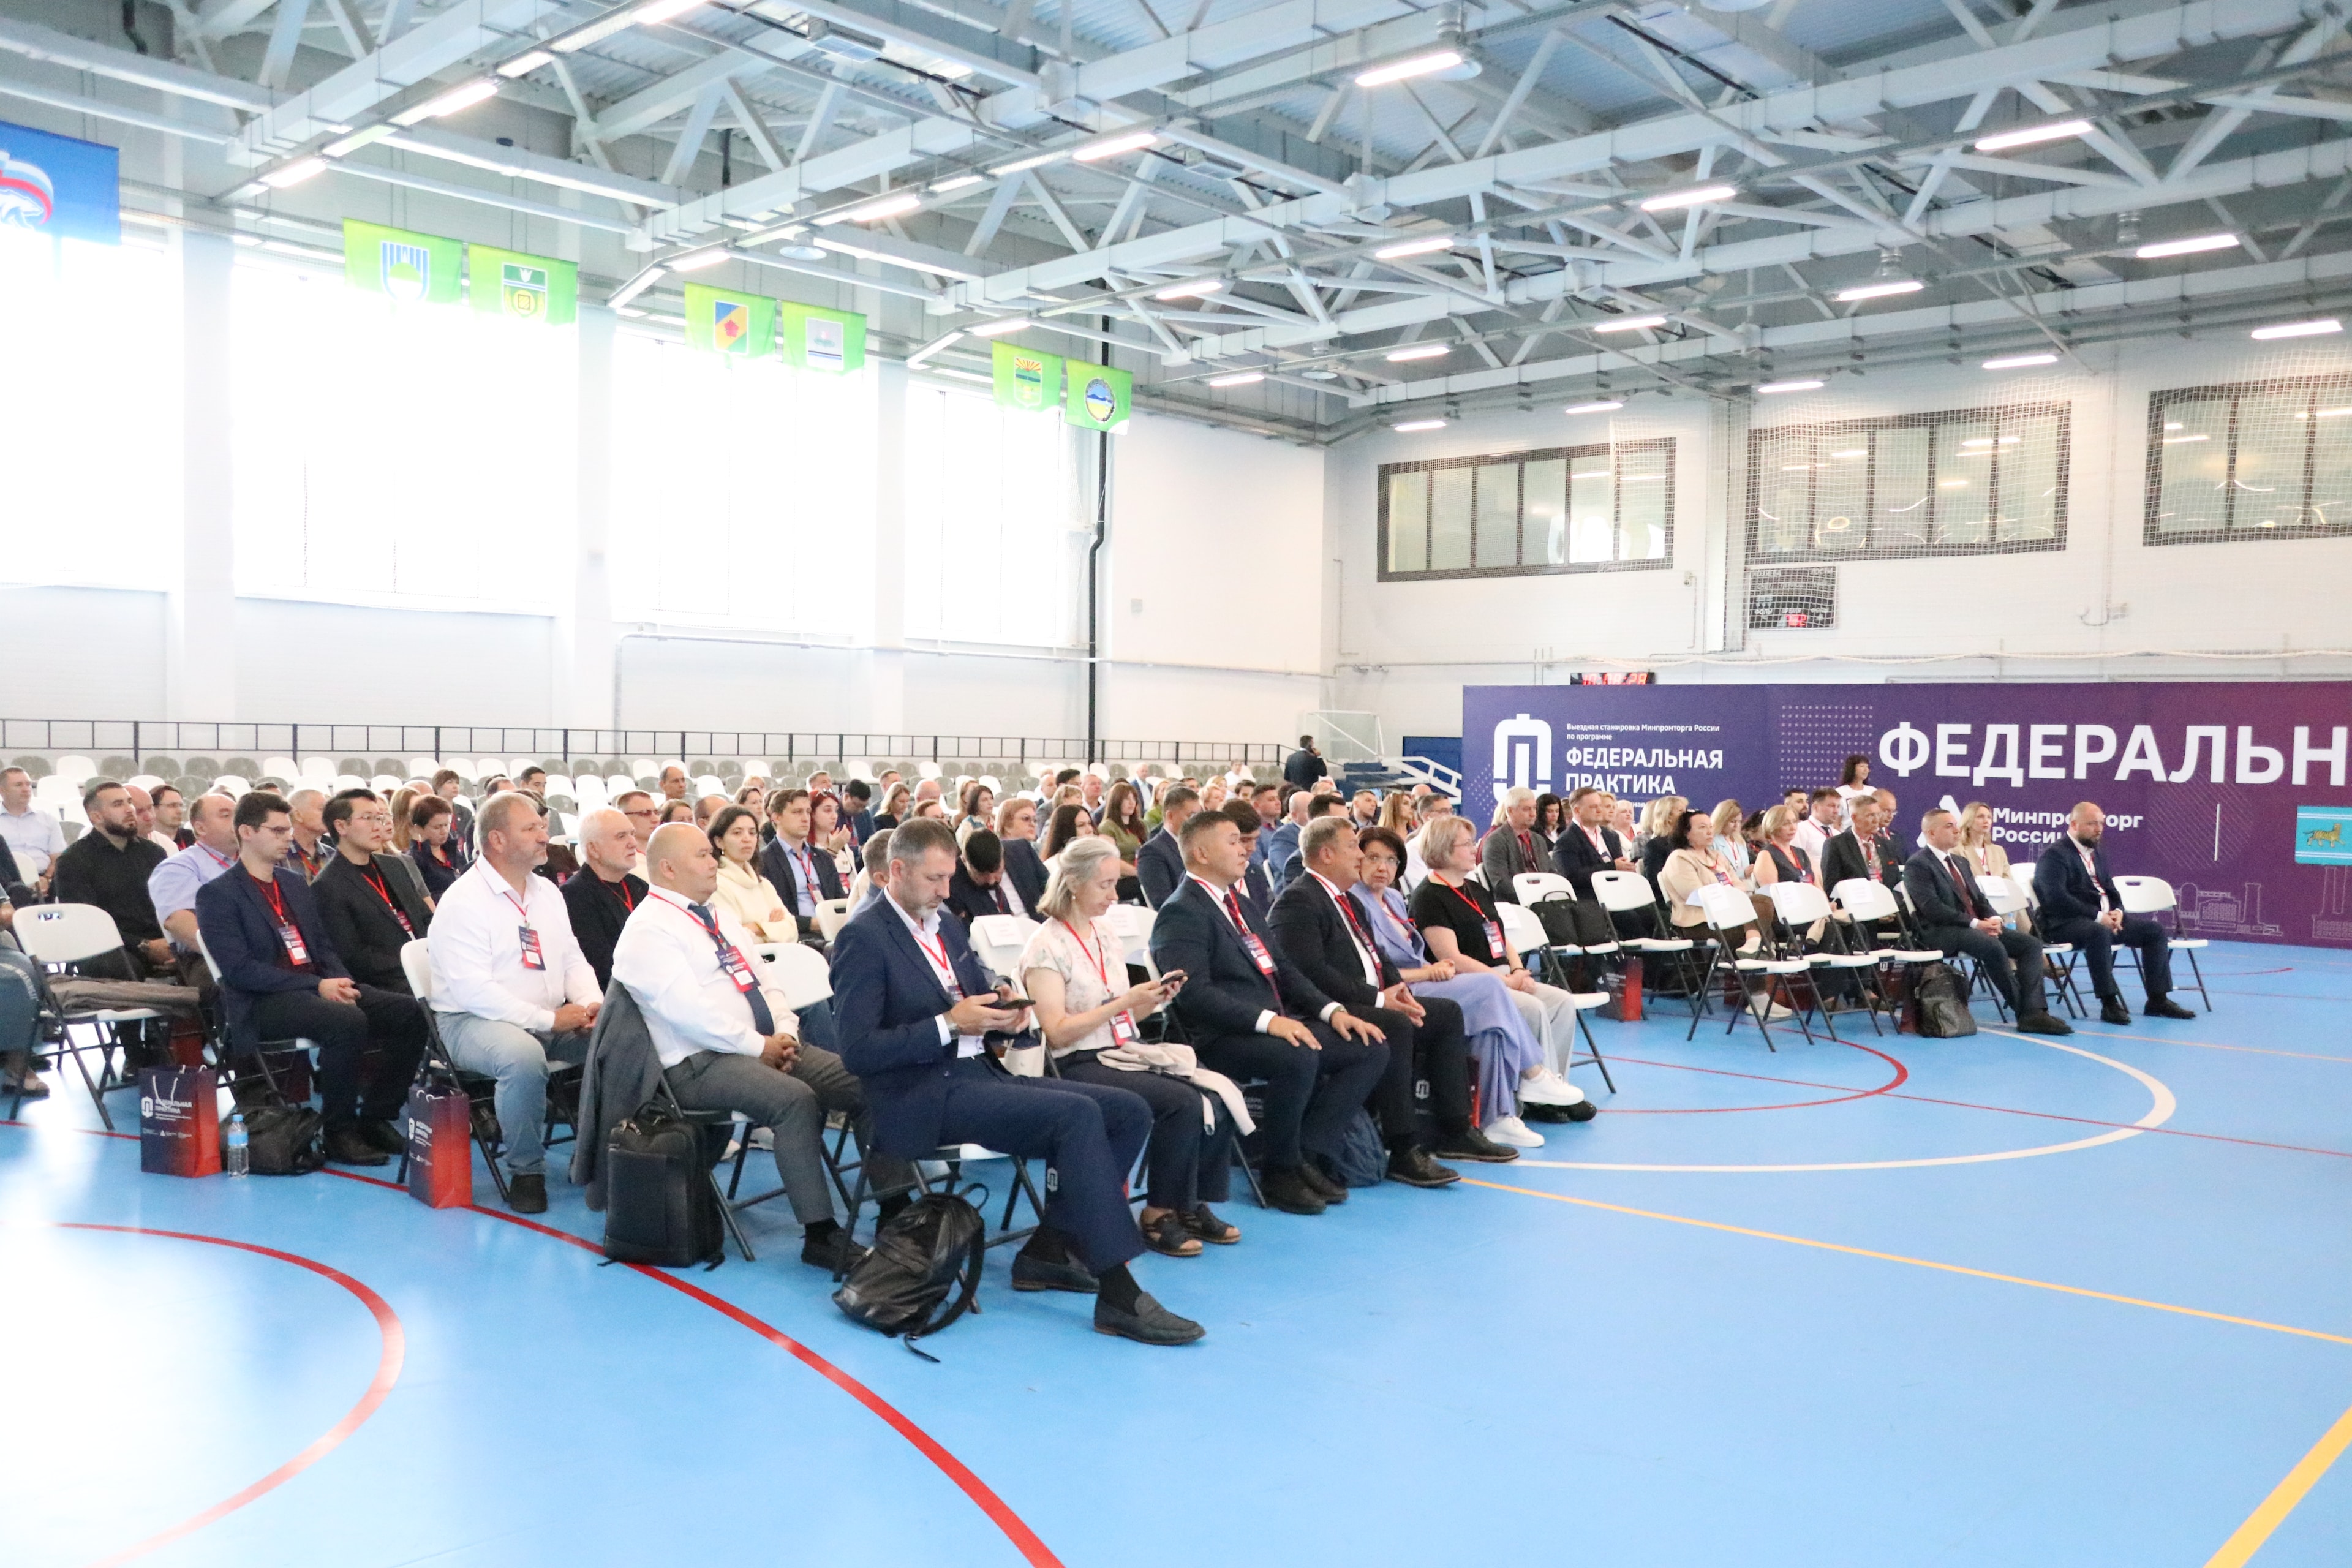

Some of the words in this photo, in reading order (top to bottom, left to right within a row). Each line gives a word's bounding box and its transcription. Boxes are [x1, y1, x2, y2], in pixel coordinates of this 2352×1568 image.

[1566, 747, 1723, 769] ФЕДЕРАЛЬНАЯ
[1879, 722, 2348, 787] ФЕДЕРАЛЬН
[1566, 773, 1676, 794] ПРАКТИКА
[1992, 807, 2143, 831] Минпрорг
[1992, 826, 2061, 843] Росси
